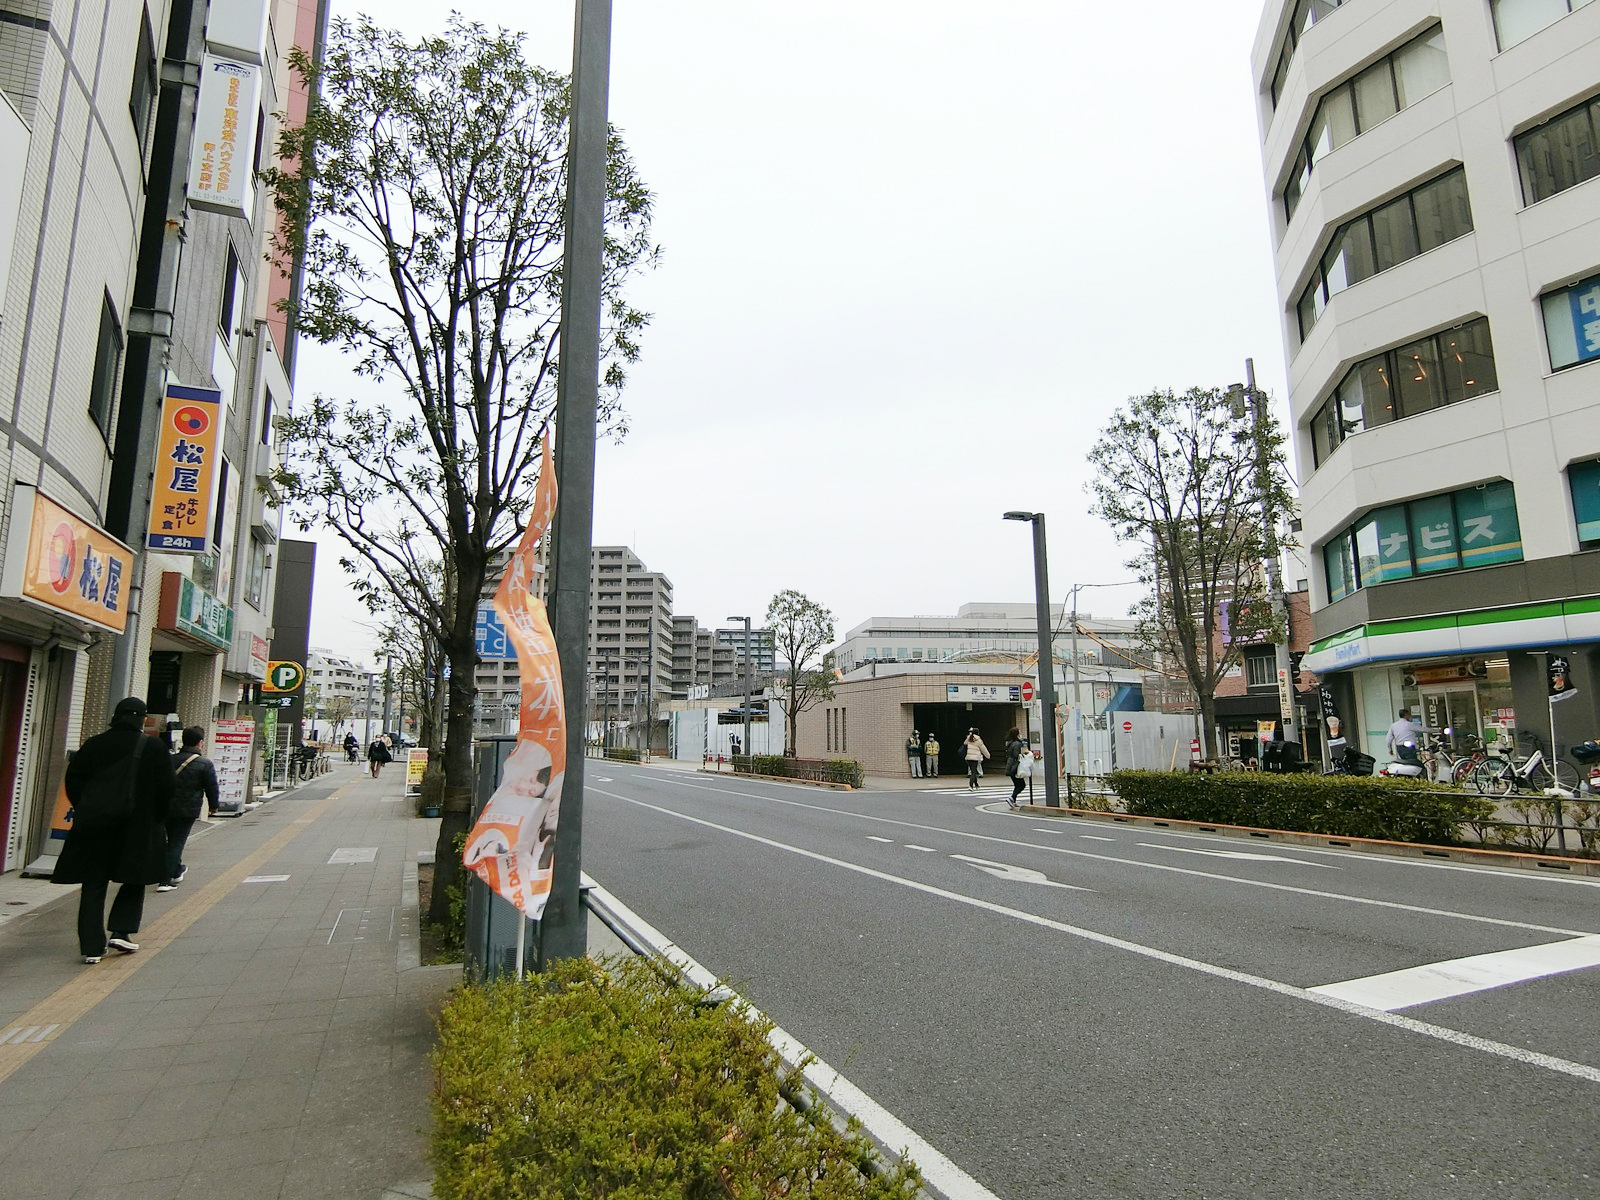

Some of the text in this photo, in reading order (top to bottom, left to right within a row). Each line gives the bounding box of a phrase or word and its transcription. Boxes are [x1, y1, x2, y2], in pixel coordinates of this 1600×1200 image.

[168, 438, 205, 493] 松屋
[162, 505, 175, 530] 定食
[175, 502, 186, 528] カレー
[186, 498, 198, 525] 牛めし
[162, 536, 191, 548] 24h
[1380, 514, 1496, 557] ナビス
[78, 543, 123, 613] 松屋
[1334, 642, 1361, 661] FamilyMart
[278, 667, 297, 687] P
[971, 686, 997, 695] 押上駅
